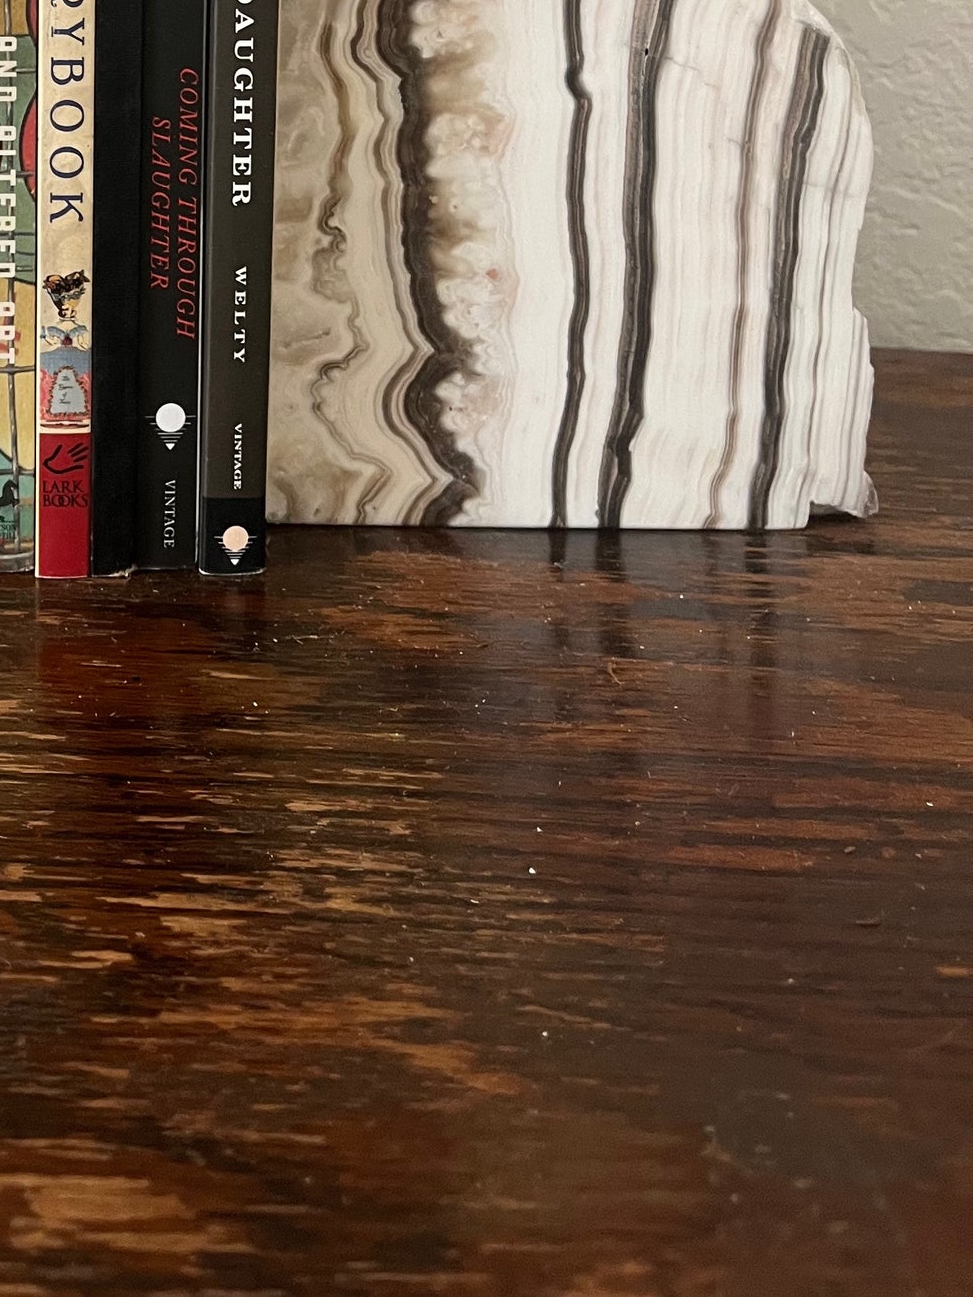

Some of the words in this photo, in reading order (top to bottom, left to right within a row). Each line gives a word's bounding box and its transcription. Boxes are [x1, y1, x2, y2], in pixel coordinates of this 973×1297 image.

[178, 68, 199, 185] COMING
[150, 116, 171, 289] SLAUGHTER
[176, 197, 197, 340] THROUGH
[232, 266, 247, 363] WELTY
[42, 480, 84, 494] LARK
[233, 423, 243, 490] VINTAGE
[43, 493, 89, 508] BOOKS
[163, 479, 176, 548] VINTAGE
